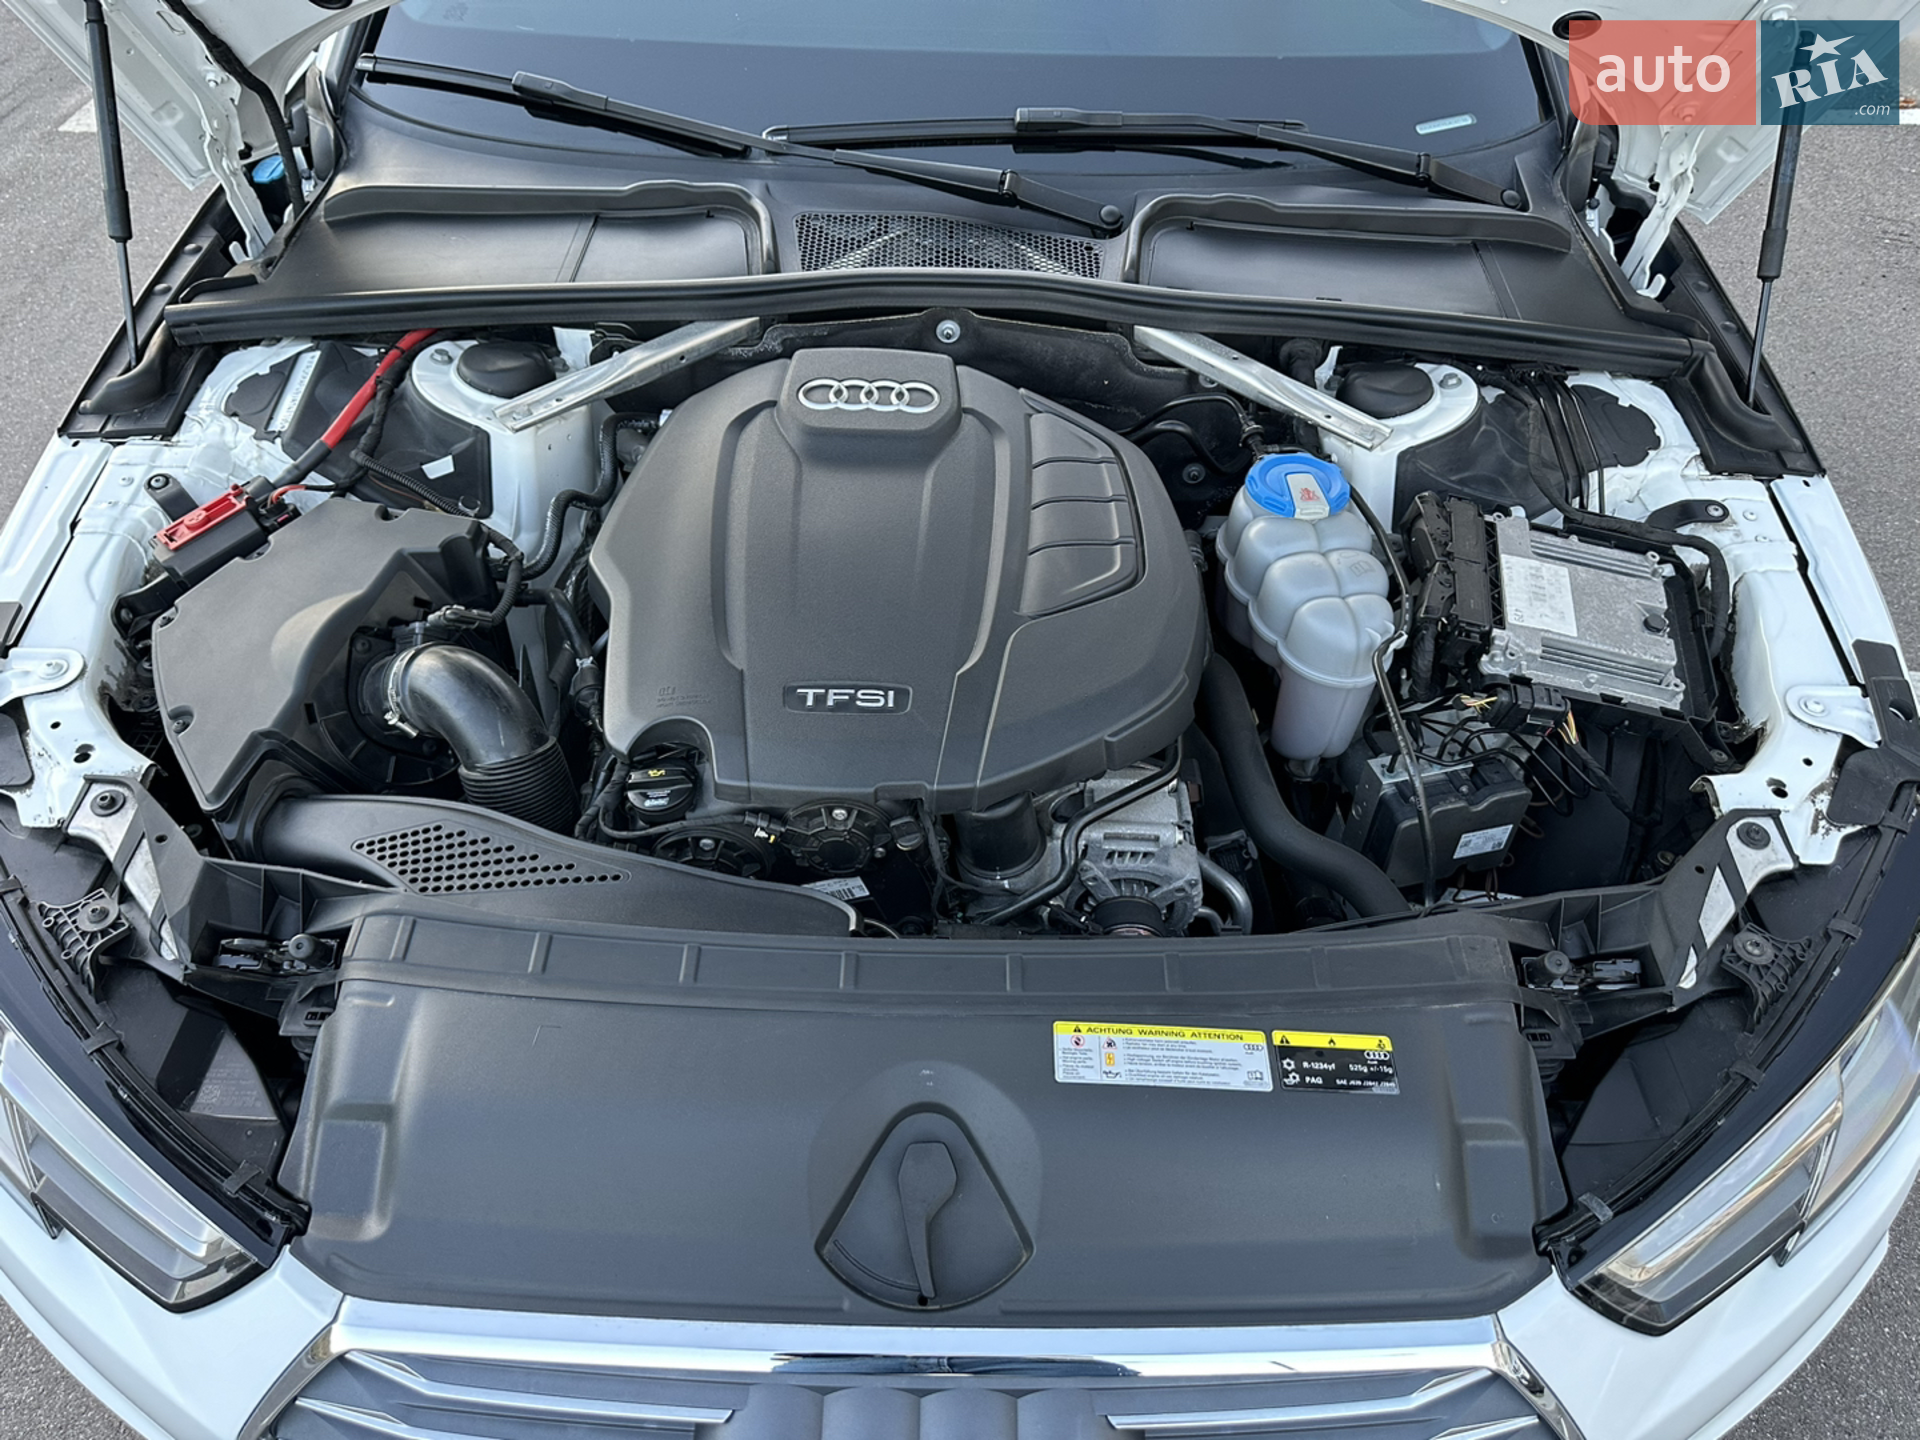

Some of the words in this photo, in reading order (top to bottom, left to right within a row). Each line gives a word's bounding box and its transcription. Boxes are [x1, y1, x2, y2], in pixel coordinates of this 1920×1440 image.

[796, 688, 895, 708] TFSI
[1086, 1026, 1133, 1036] ACHTUNG
[1137, 1028, 1186, 1038] WARNING
[1190, 1031, 1244, 1041] ATTENTION
[1302, 1061, 1336, 1072] R-1234yf
